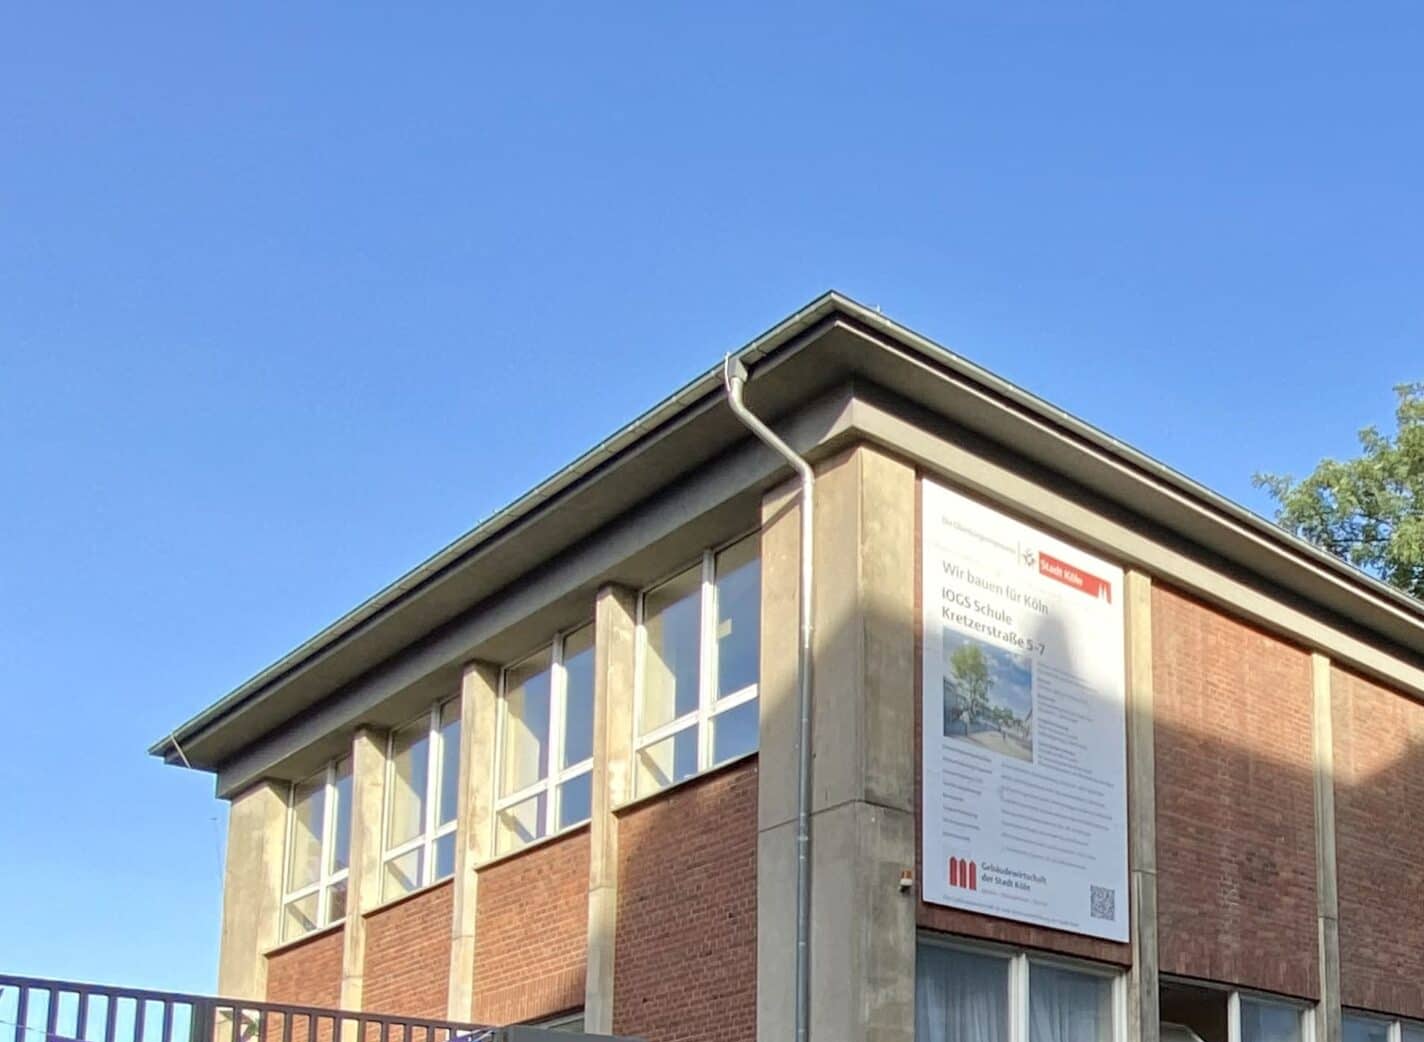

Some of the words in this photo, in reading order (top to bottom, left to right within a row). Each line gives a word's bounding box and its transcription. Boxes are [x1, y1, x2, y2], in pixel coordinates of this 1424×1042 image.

[942, 560, 965, 579] Wir
[967, 569, 1003, 596] bauen
[1006, 584, 1022, 603] für
[1024, 594, 1049, 615] Köln
[1040, 559, 1063, 578] Stadt
[1063, 568, 1083, 587] Köln
[942, 587, 971, 609] IOGS
[974, 600, 1013, 625] Schule
[941, 605, 1025, 648] Kretzerstraße
[1026, 639, 1046, 656] 5-7
